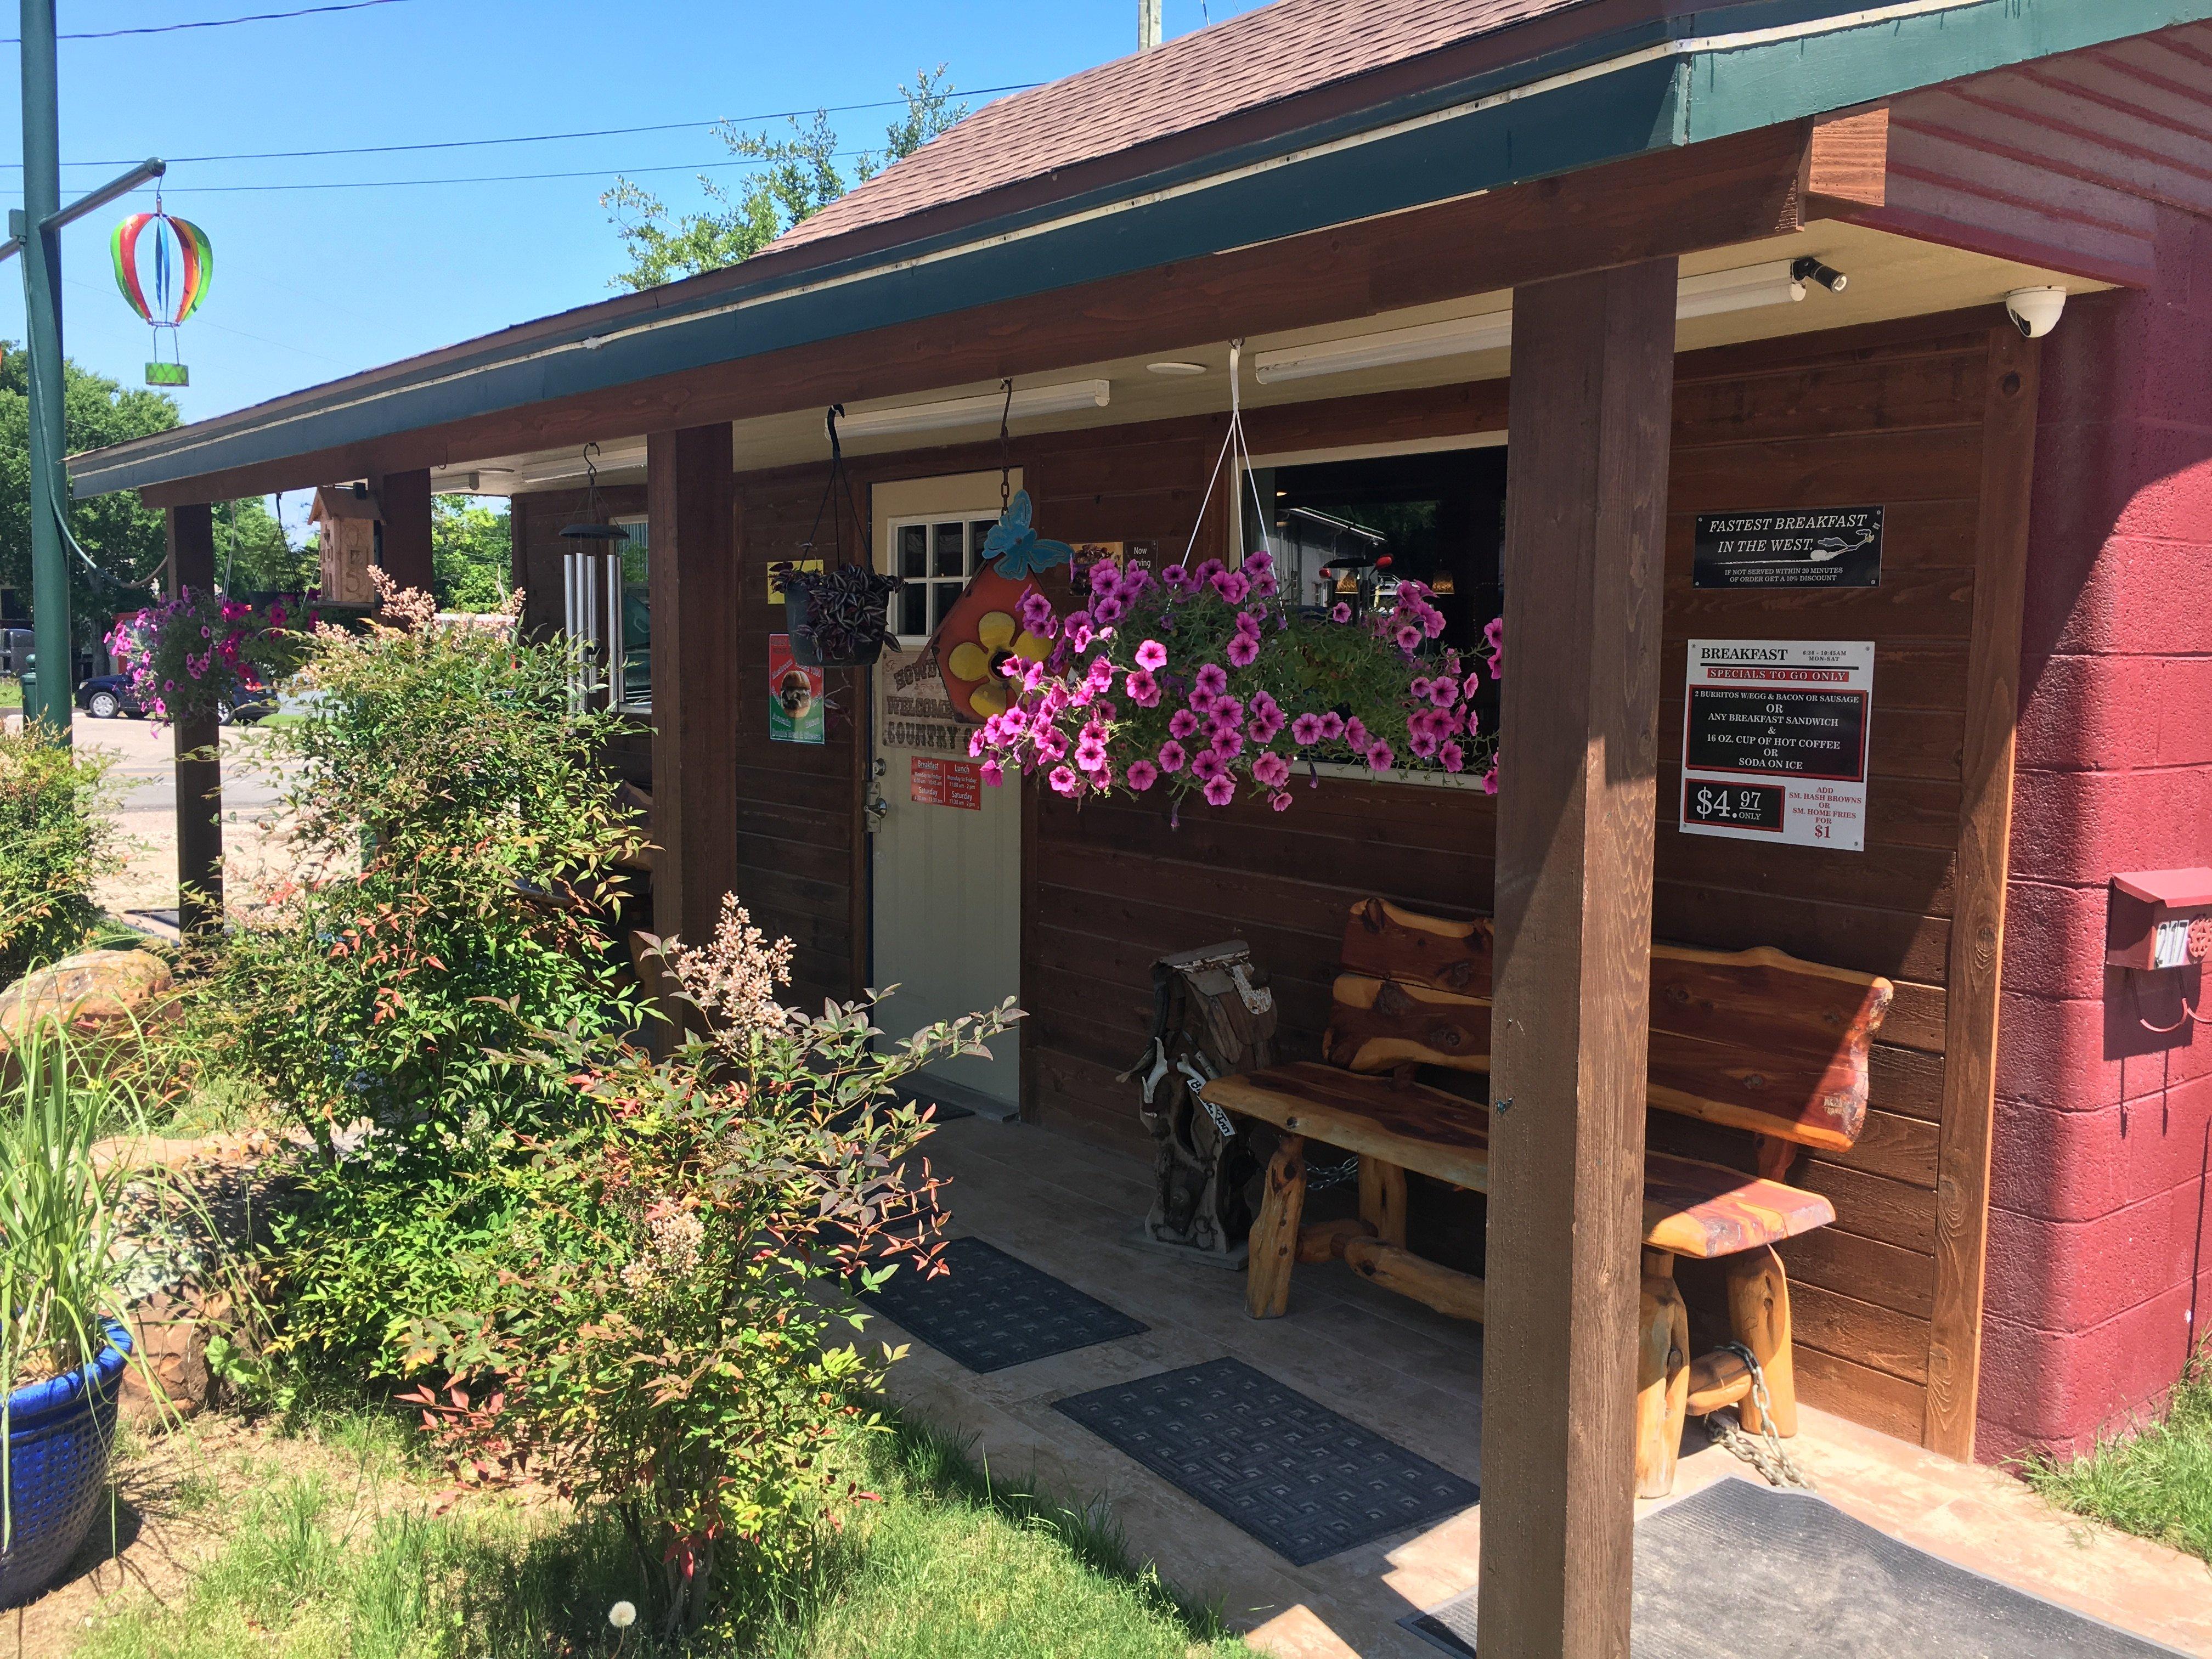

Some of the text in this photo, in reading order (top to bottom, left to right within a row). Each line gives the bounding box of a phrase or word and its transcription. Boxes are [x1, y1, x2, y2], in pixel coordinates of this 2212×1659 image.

[1709, 514, 1867, 532] FASTEST BREAKFAST
[1718, 538, 1813, 552] IN THE WEST.
[1137, 558, 1151, 568] ving
[1701, 647, 1788, 661] BREAKFAST
[894, 659, 942, 691] HOWD
[1710, 669, 1846, 681] SPECIALS TO GO ONLY
[1766, 704, 1783, 713] OR
[1729, 714, 1784, 723] BREAKFAST
[1786, 716, 1838, 726] SANDWICH
[887, 721, 958, 750] COUNTRY
[1768, 726, 1776, 735] &
[1707, 734, 1841, 749] 16 OZ. CUP OF HOT COFFEE
[1763, 748, 1778, 758] OR
[918, 760, 939, 769] Breakfast
[955, 764, 969, 772] Lunch
[1739, 757, 1803, 770] SODA ON ICE
[918, 786, 938, 797] Saturday
[952, 791, 972, 801] Saturday
[1827, 795, 1861, 804] BROWNS
[1739, 811, 1761, 820] ONLY
[1815, 824, 1831, 839] $1
